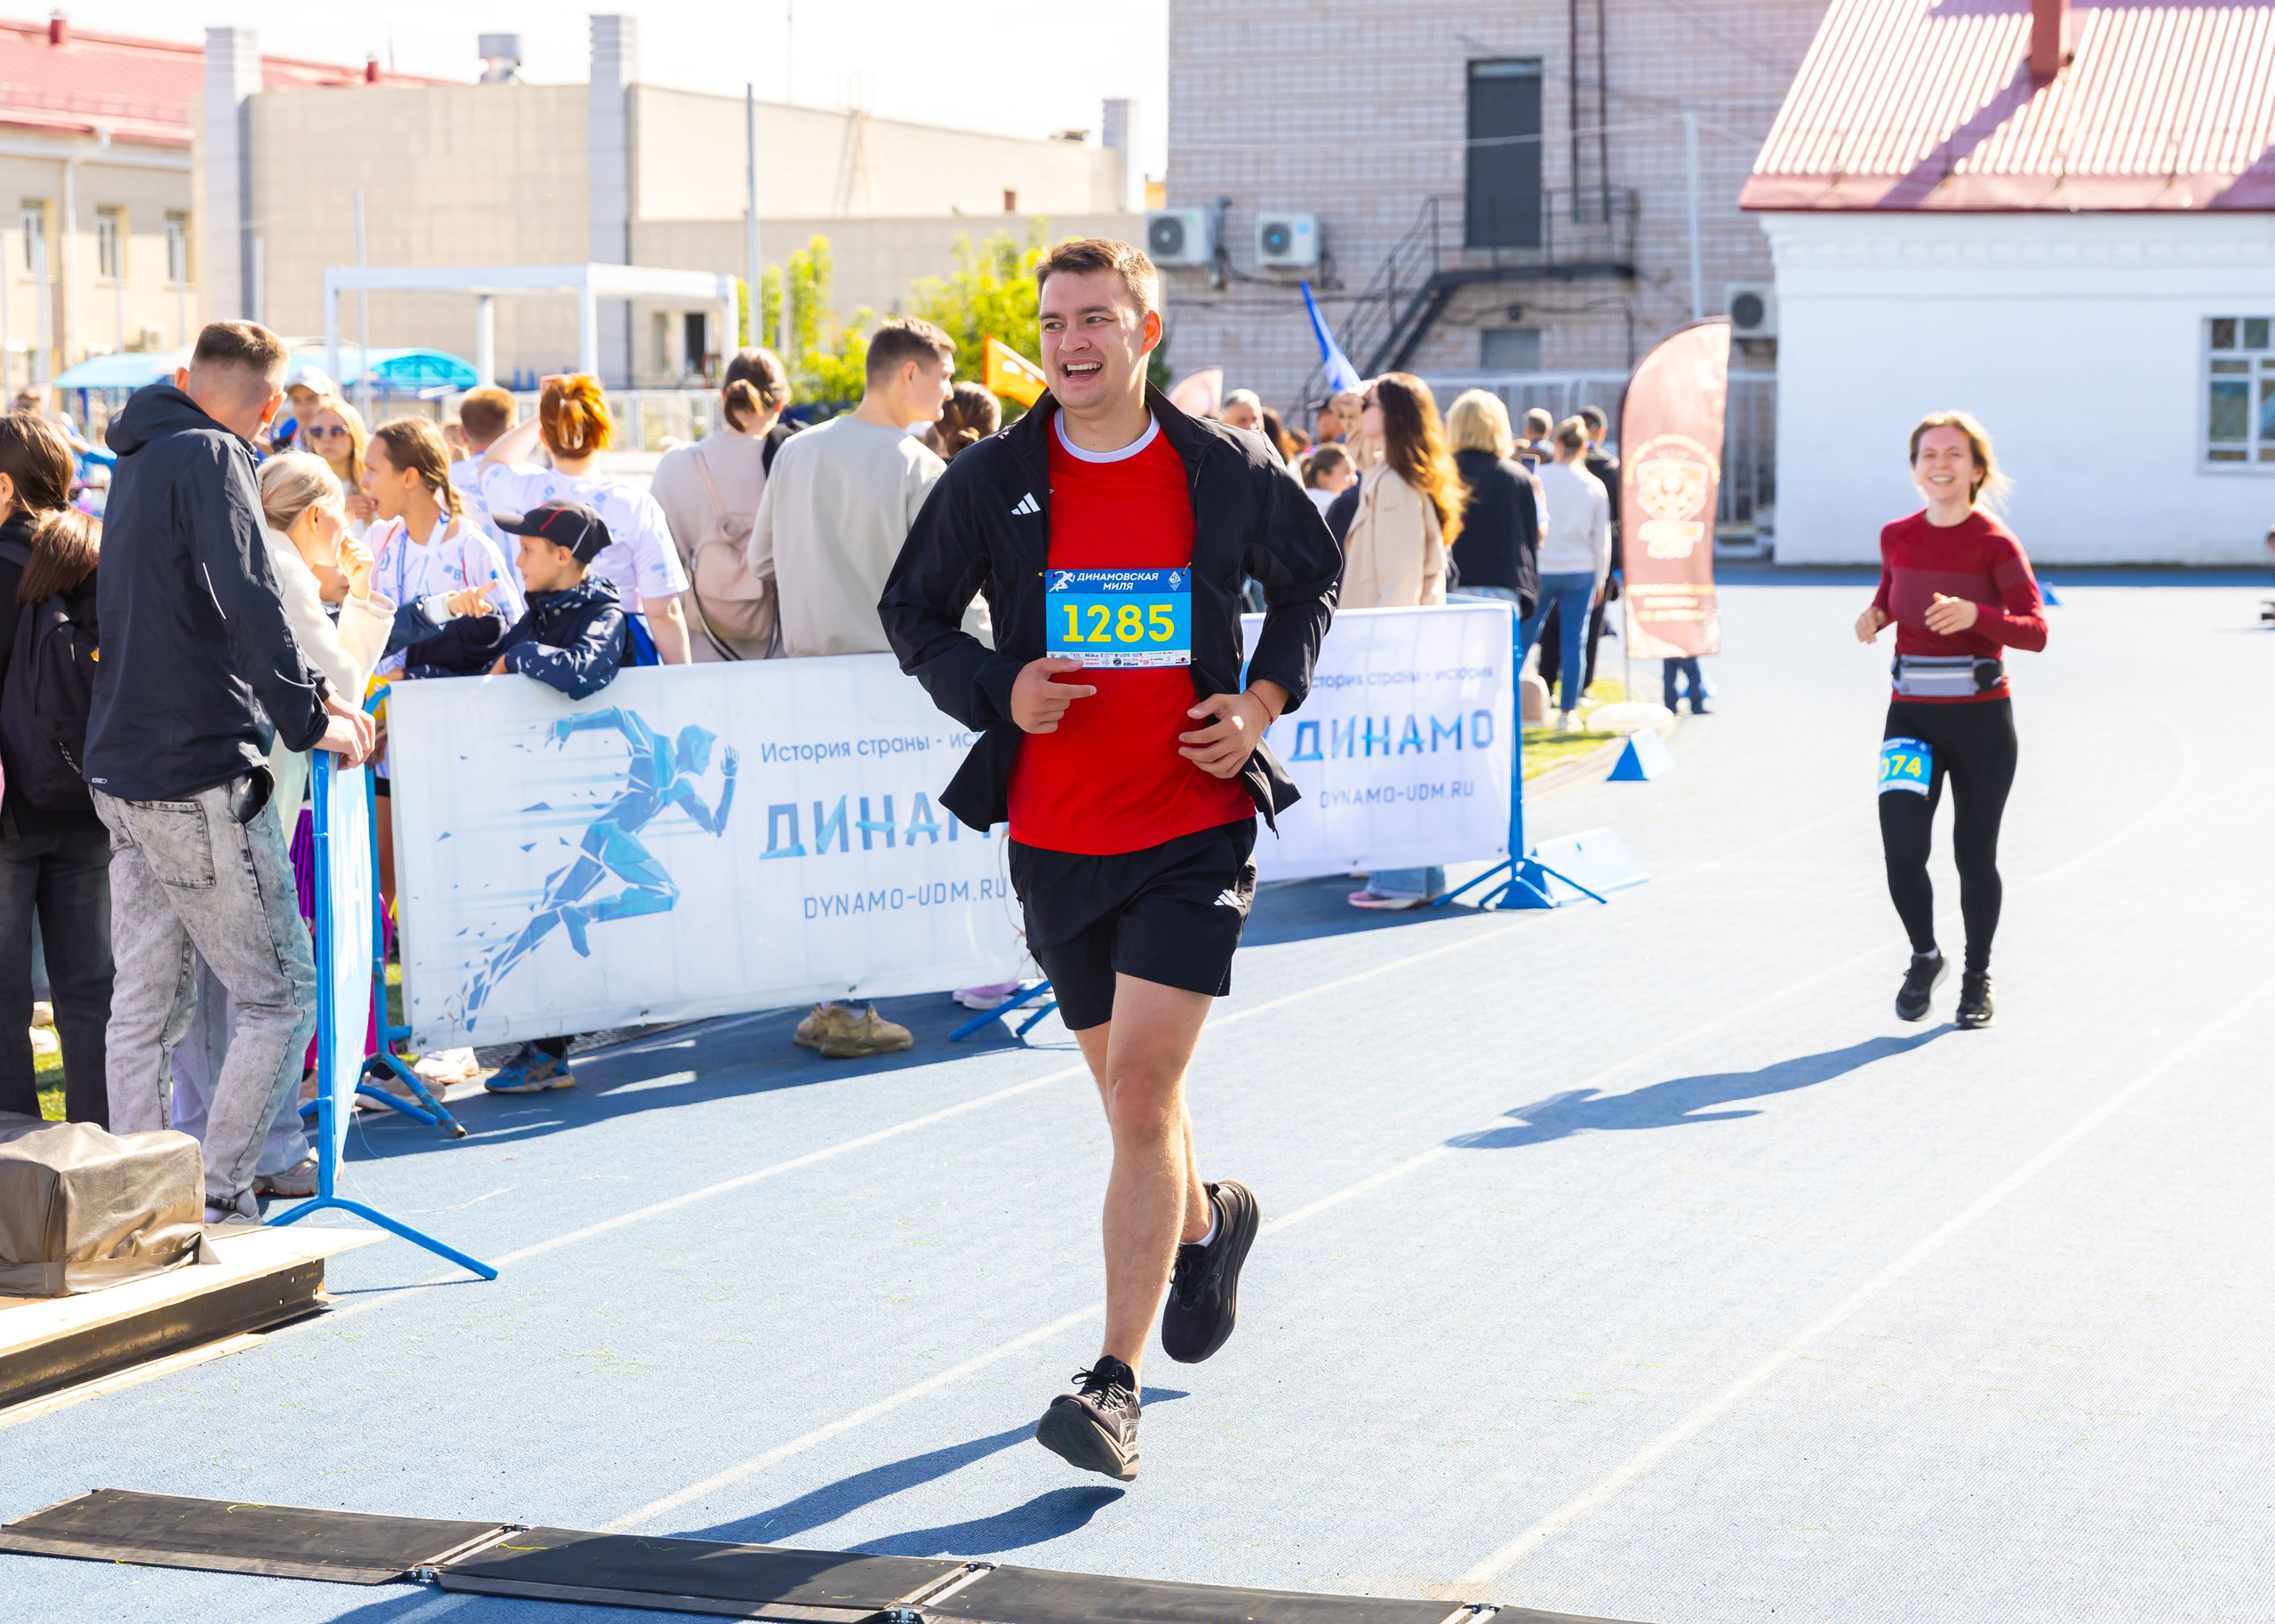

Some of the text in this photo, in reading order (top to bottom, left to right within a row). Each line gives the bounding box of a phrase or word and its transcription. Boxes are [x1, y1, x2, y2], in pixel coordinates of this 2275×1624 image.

[1077, 572, 1159, 582] ДИНАМОВСКАЯ
[1103, 582, 1134, 591] МИЛЯ
[1063, 604, 1175, 643] 1285
[1312, 673, 1363, 690] стория
[1366, 670, 1422, 686] страны
[761, 742, 851, 763] История
[857, 736, 930, 759] страны
[1288, 709, 1495, 762] ДИНАМО
[1320, 780, 1475, 809] DYNAMO-UDM.RU
[803, 877, 1008, 919] DYNAMO-UDM.RU
